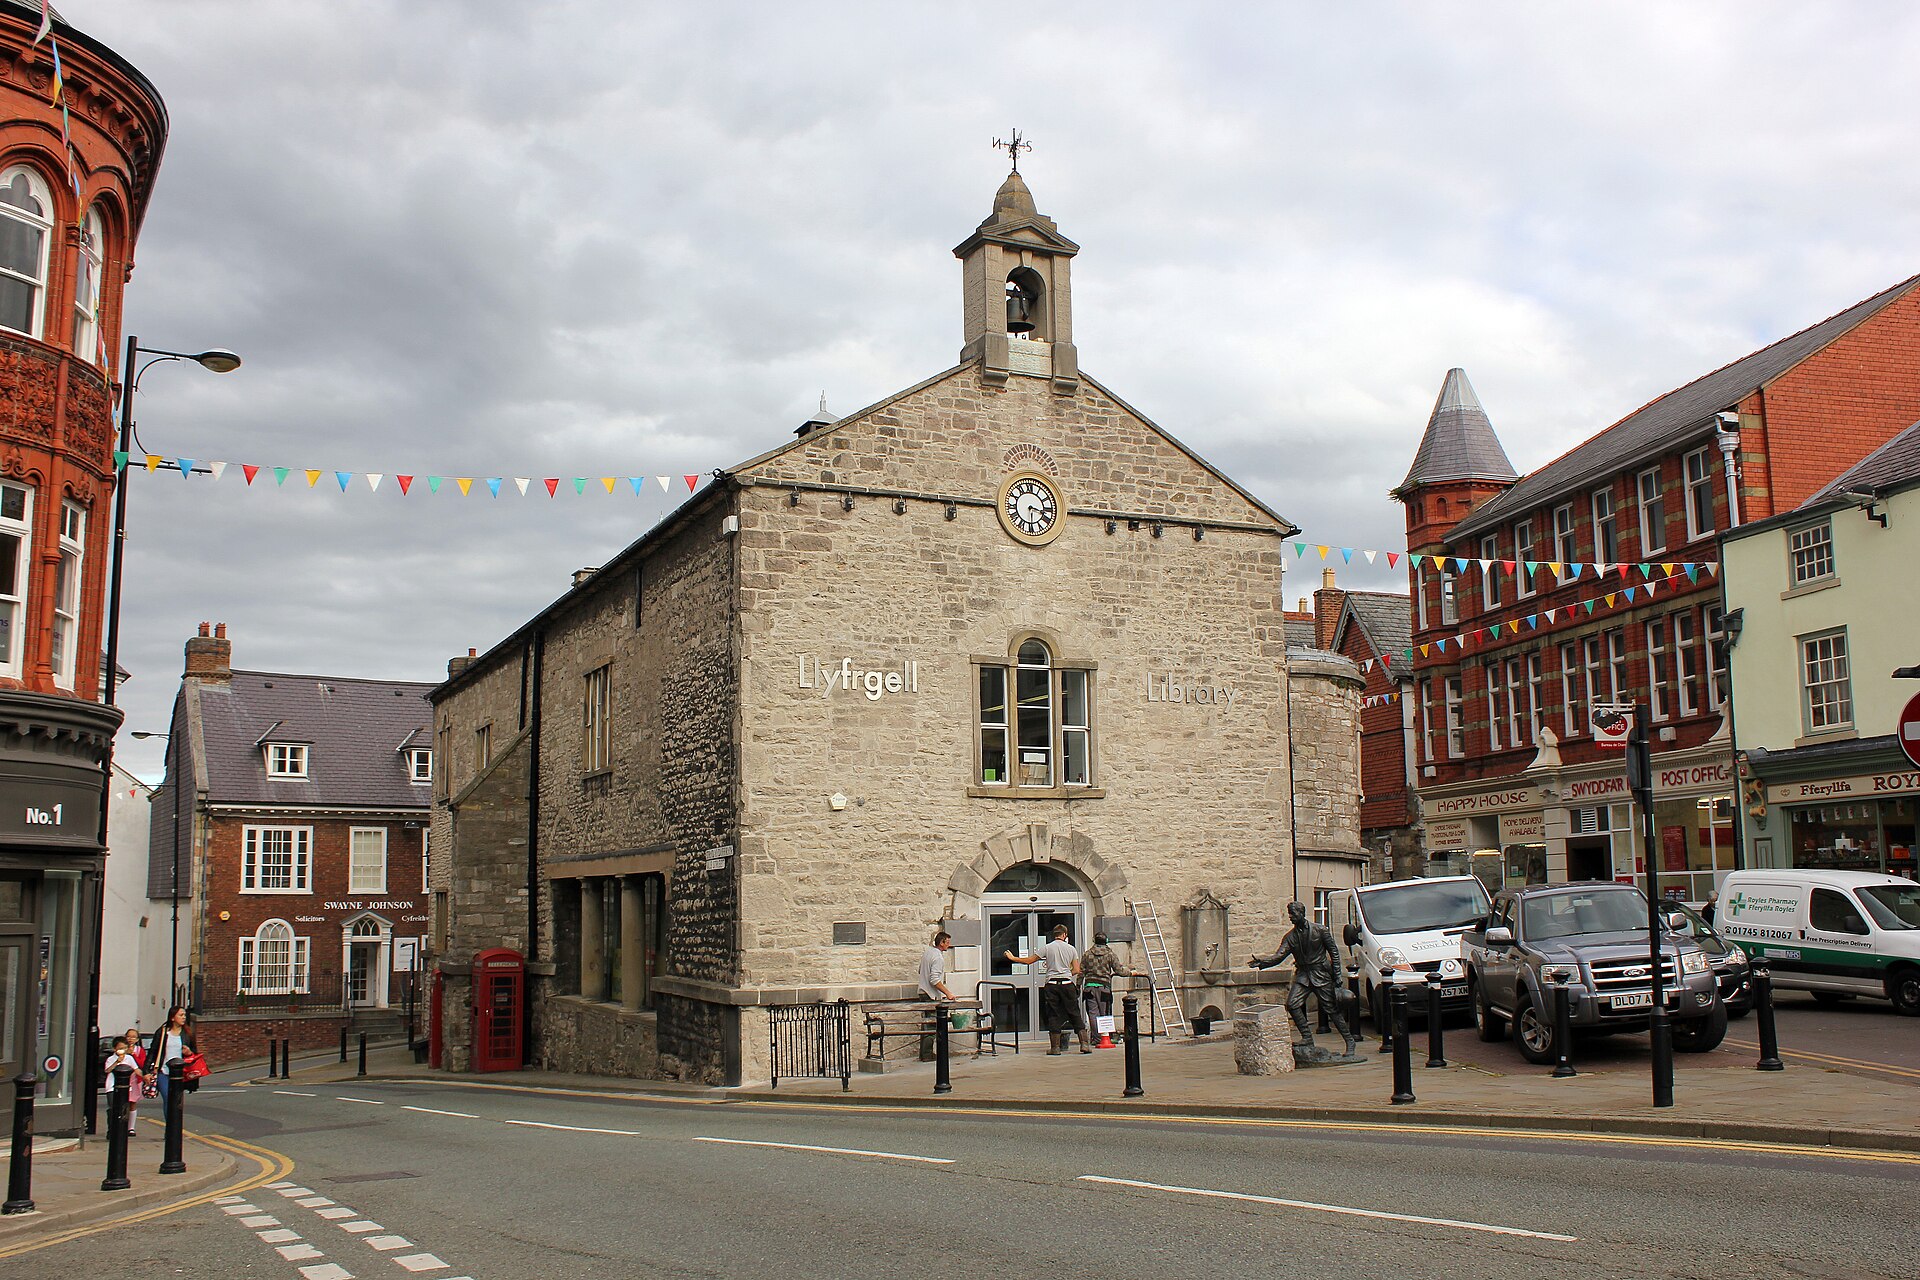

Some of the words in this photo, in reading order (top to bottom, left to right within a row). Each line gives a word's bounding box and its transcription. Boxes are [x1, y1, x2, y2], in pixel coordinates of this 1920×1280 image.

[799, 655, 918, 701] Llyfrgell
[1147, 671, 1239, 714] Library
[1661, 769, 1689, 786] POST
[1800, 781, 1851, 796] Fferyllfa
[1437, 796, 1477, 812] HAPPY
[1480, 791, 1529, 807] HOUSE
[26, 803, 63, 825] No.1
[1503, 818, 1518, 827] HOME
[1519, 816, 1542, 825] DELIVERY
[1509, 827, 1537, 836] AVAILABLE
[324, 901, 363, 910] SWAYNE
[367, 901, 413, 910] JOHNSON
[1768, 898, 1798, 907] Pharmacy
[1774, 906, 1795, 914] Royles
[1732, 926, 1758, 936] 01745
[1760, 929, 1792, 939] 812067
[1819, 937, 1849, 946] Prescription
[1850, 941, 1872, 949] Delivery
[1786, 950, 1800, 959] NHS
[1441, 987, 1456, 997] X57
[1615, 995, 1641, 1006] DL07
